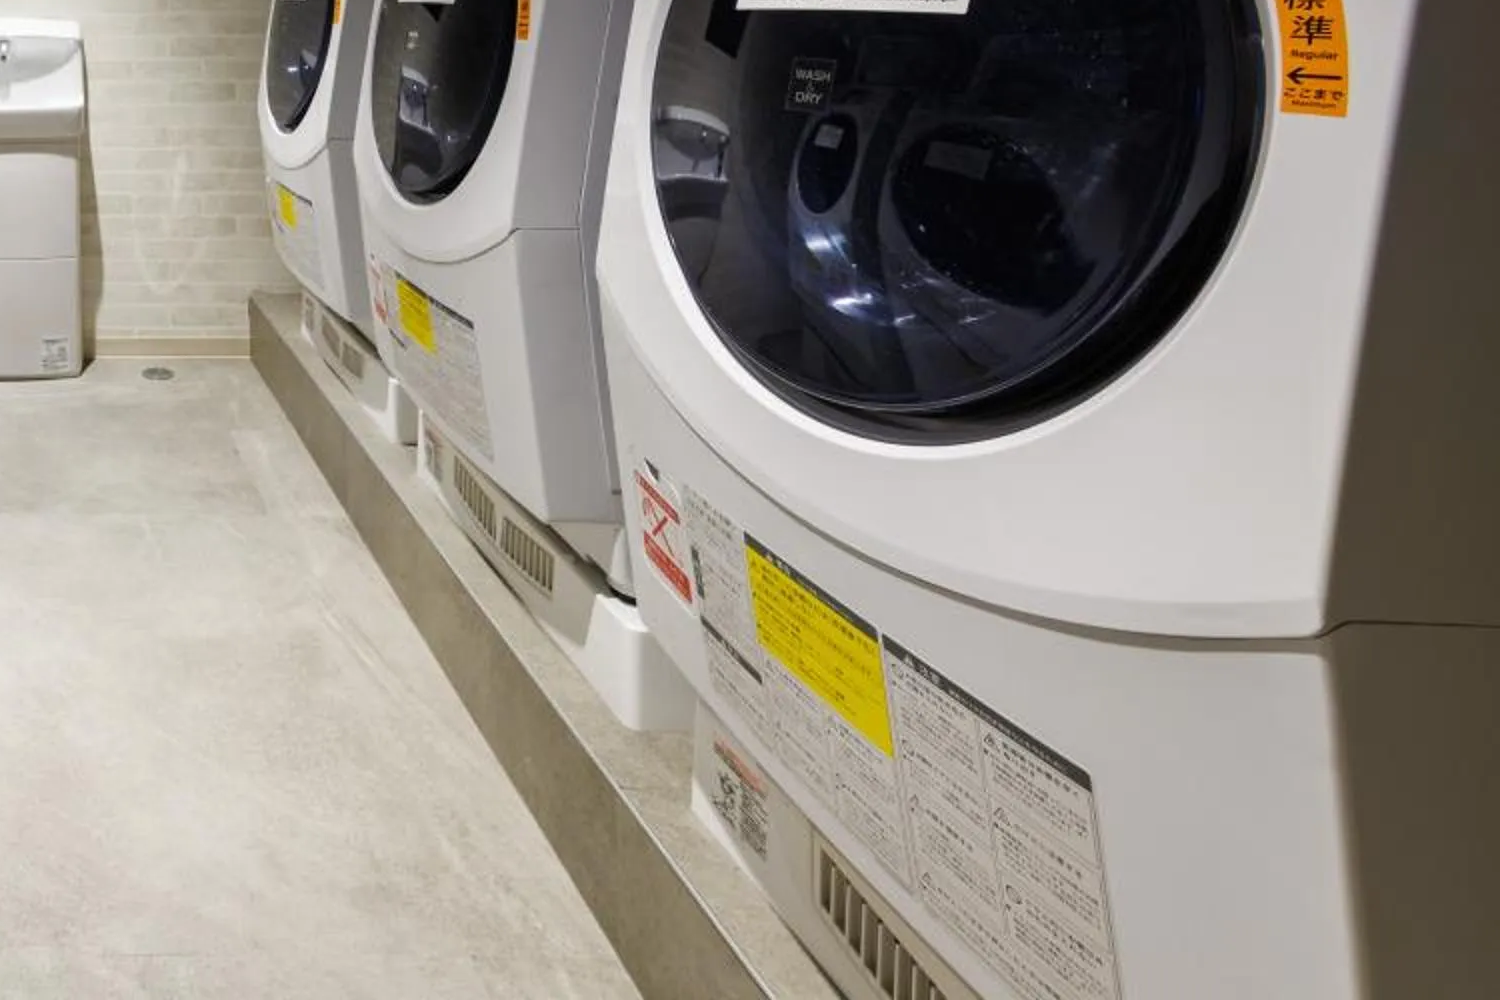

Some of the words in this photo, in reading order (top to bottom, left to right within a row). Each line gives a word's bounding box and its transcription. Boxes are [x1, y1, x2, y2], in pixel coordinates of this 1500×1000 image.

[1291, 49, 1339, 62] Regular
[1283, 87, 1345, 102] ここまで
